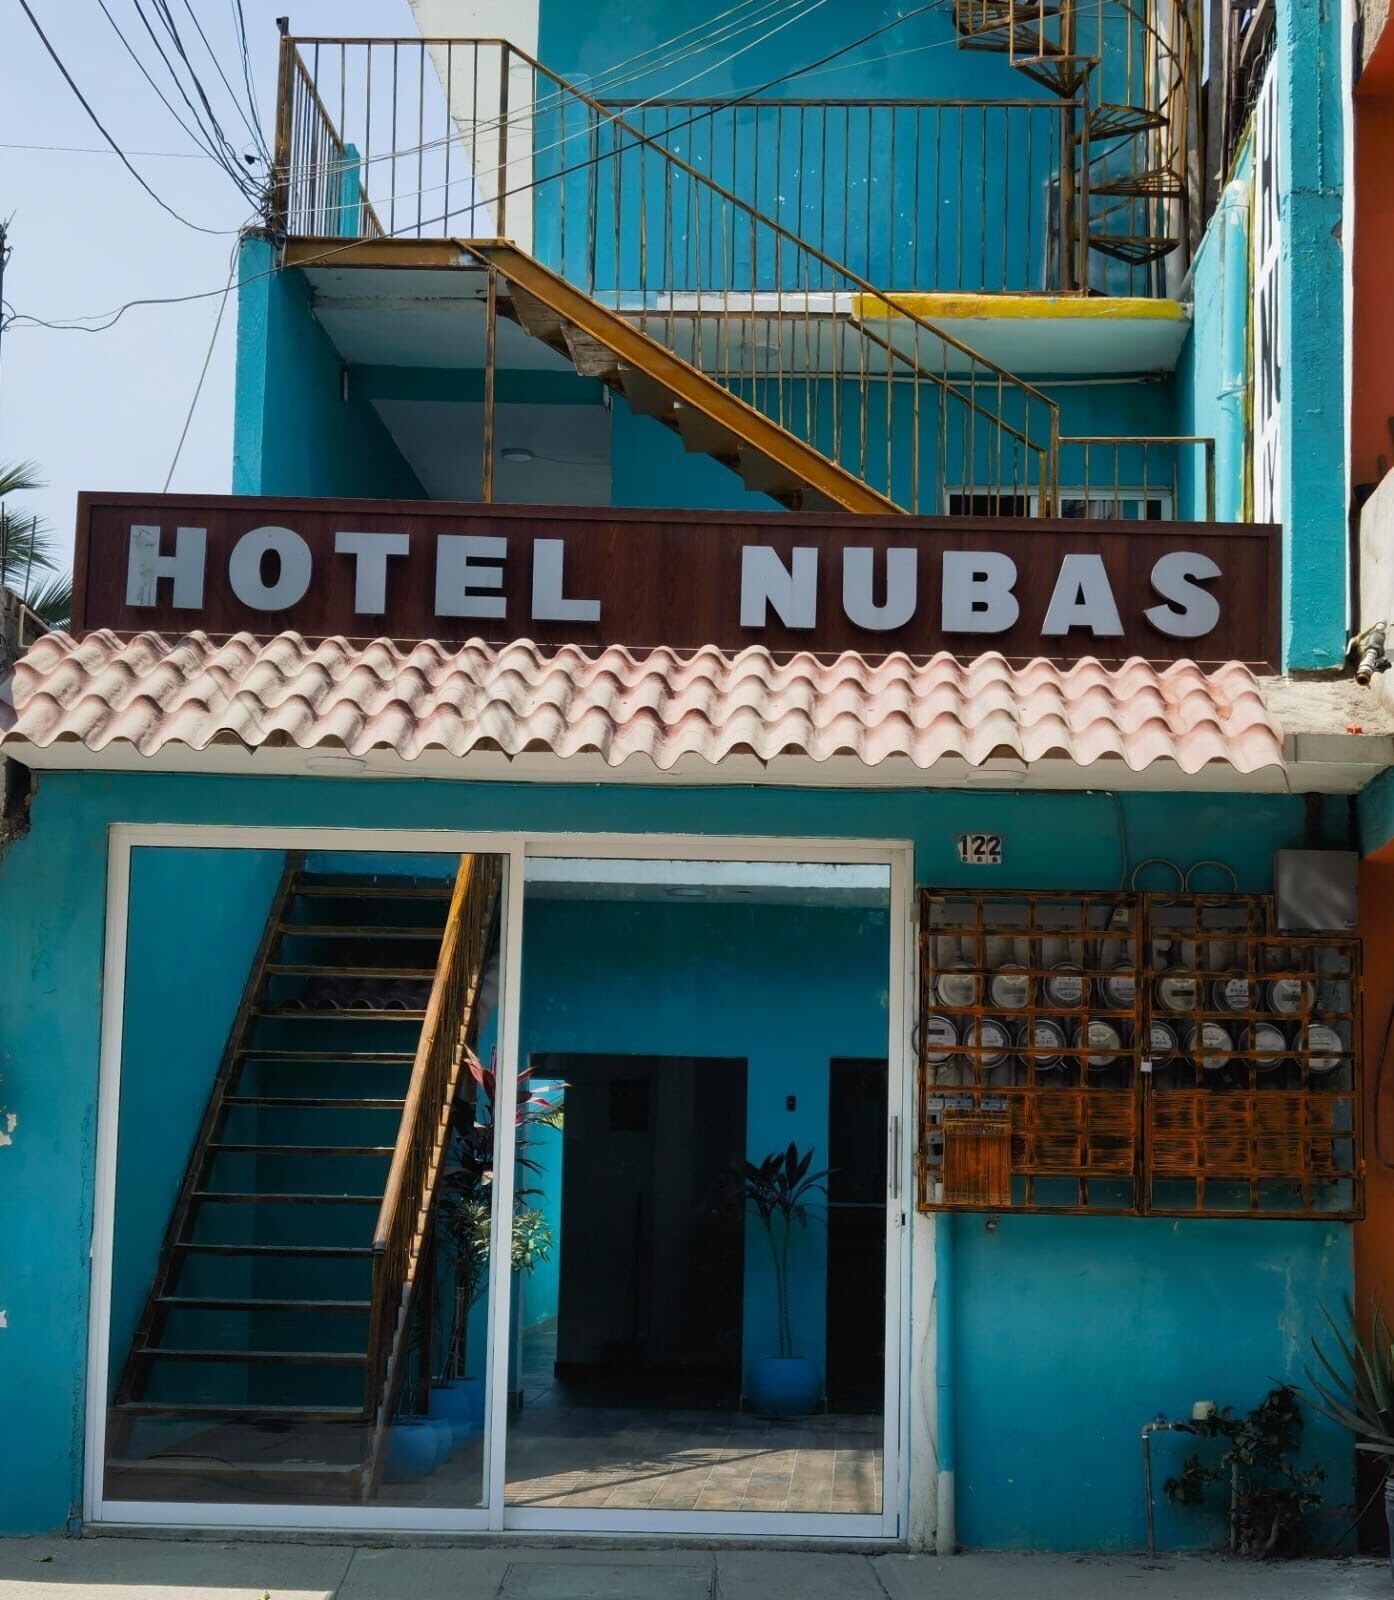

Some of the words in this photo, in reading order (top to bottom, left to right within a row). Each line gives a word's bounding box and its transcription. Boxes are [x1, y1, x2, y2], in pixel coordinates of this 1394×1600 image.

[126, 524, 601, 621] HOTEL
[739, 545, 1222, 639] NUBAS
[960, 835, 1001, 856] 122
